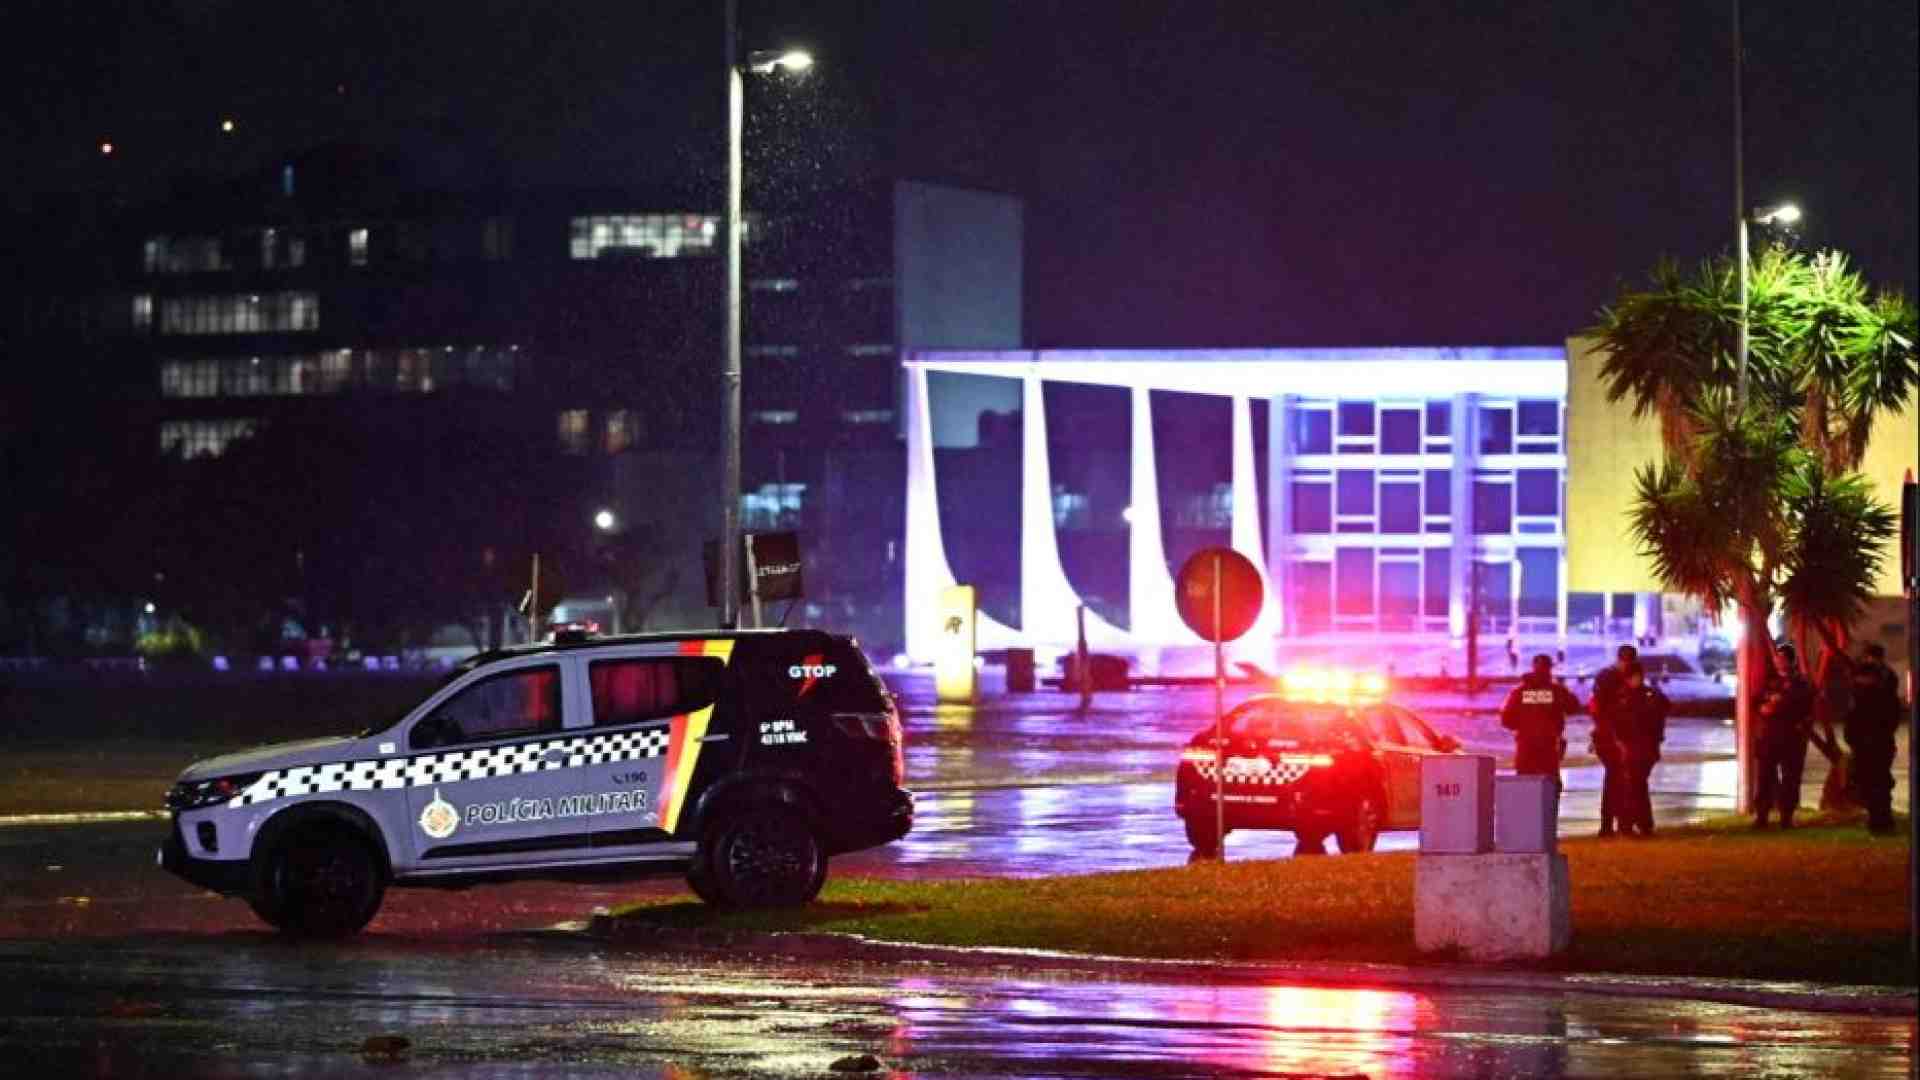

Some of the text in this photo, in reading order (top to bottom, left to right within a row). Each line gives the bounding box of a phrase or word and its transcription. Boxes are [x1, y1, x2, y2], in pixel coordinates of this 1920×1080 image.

[788, 665, 837, 678] GTOP
[625, 770, 647, 784] 190
[465, 790, 648, 825] POLÍCIA MILITAR
